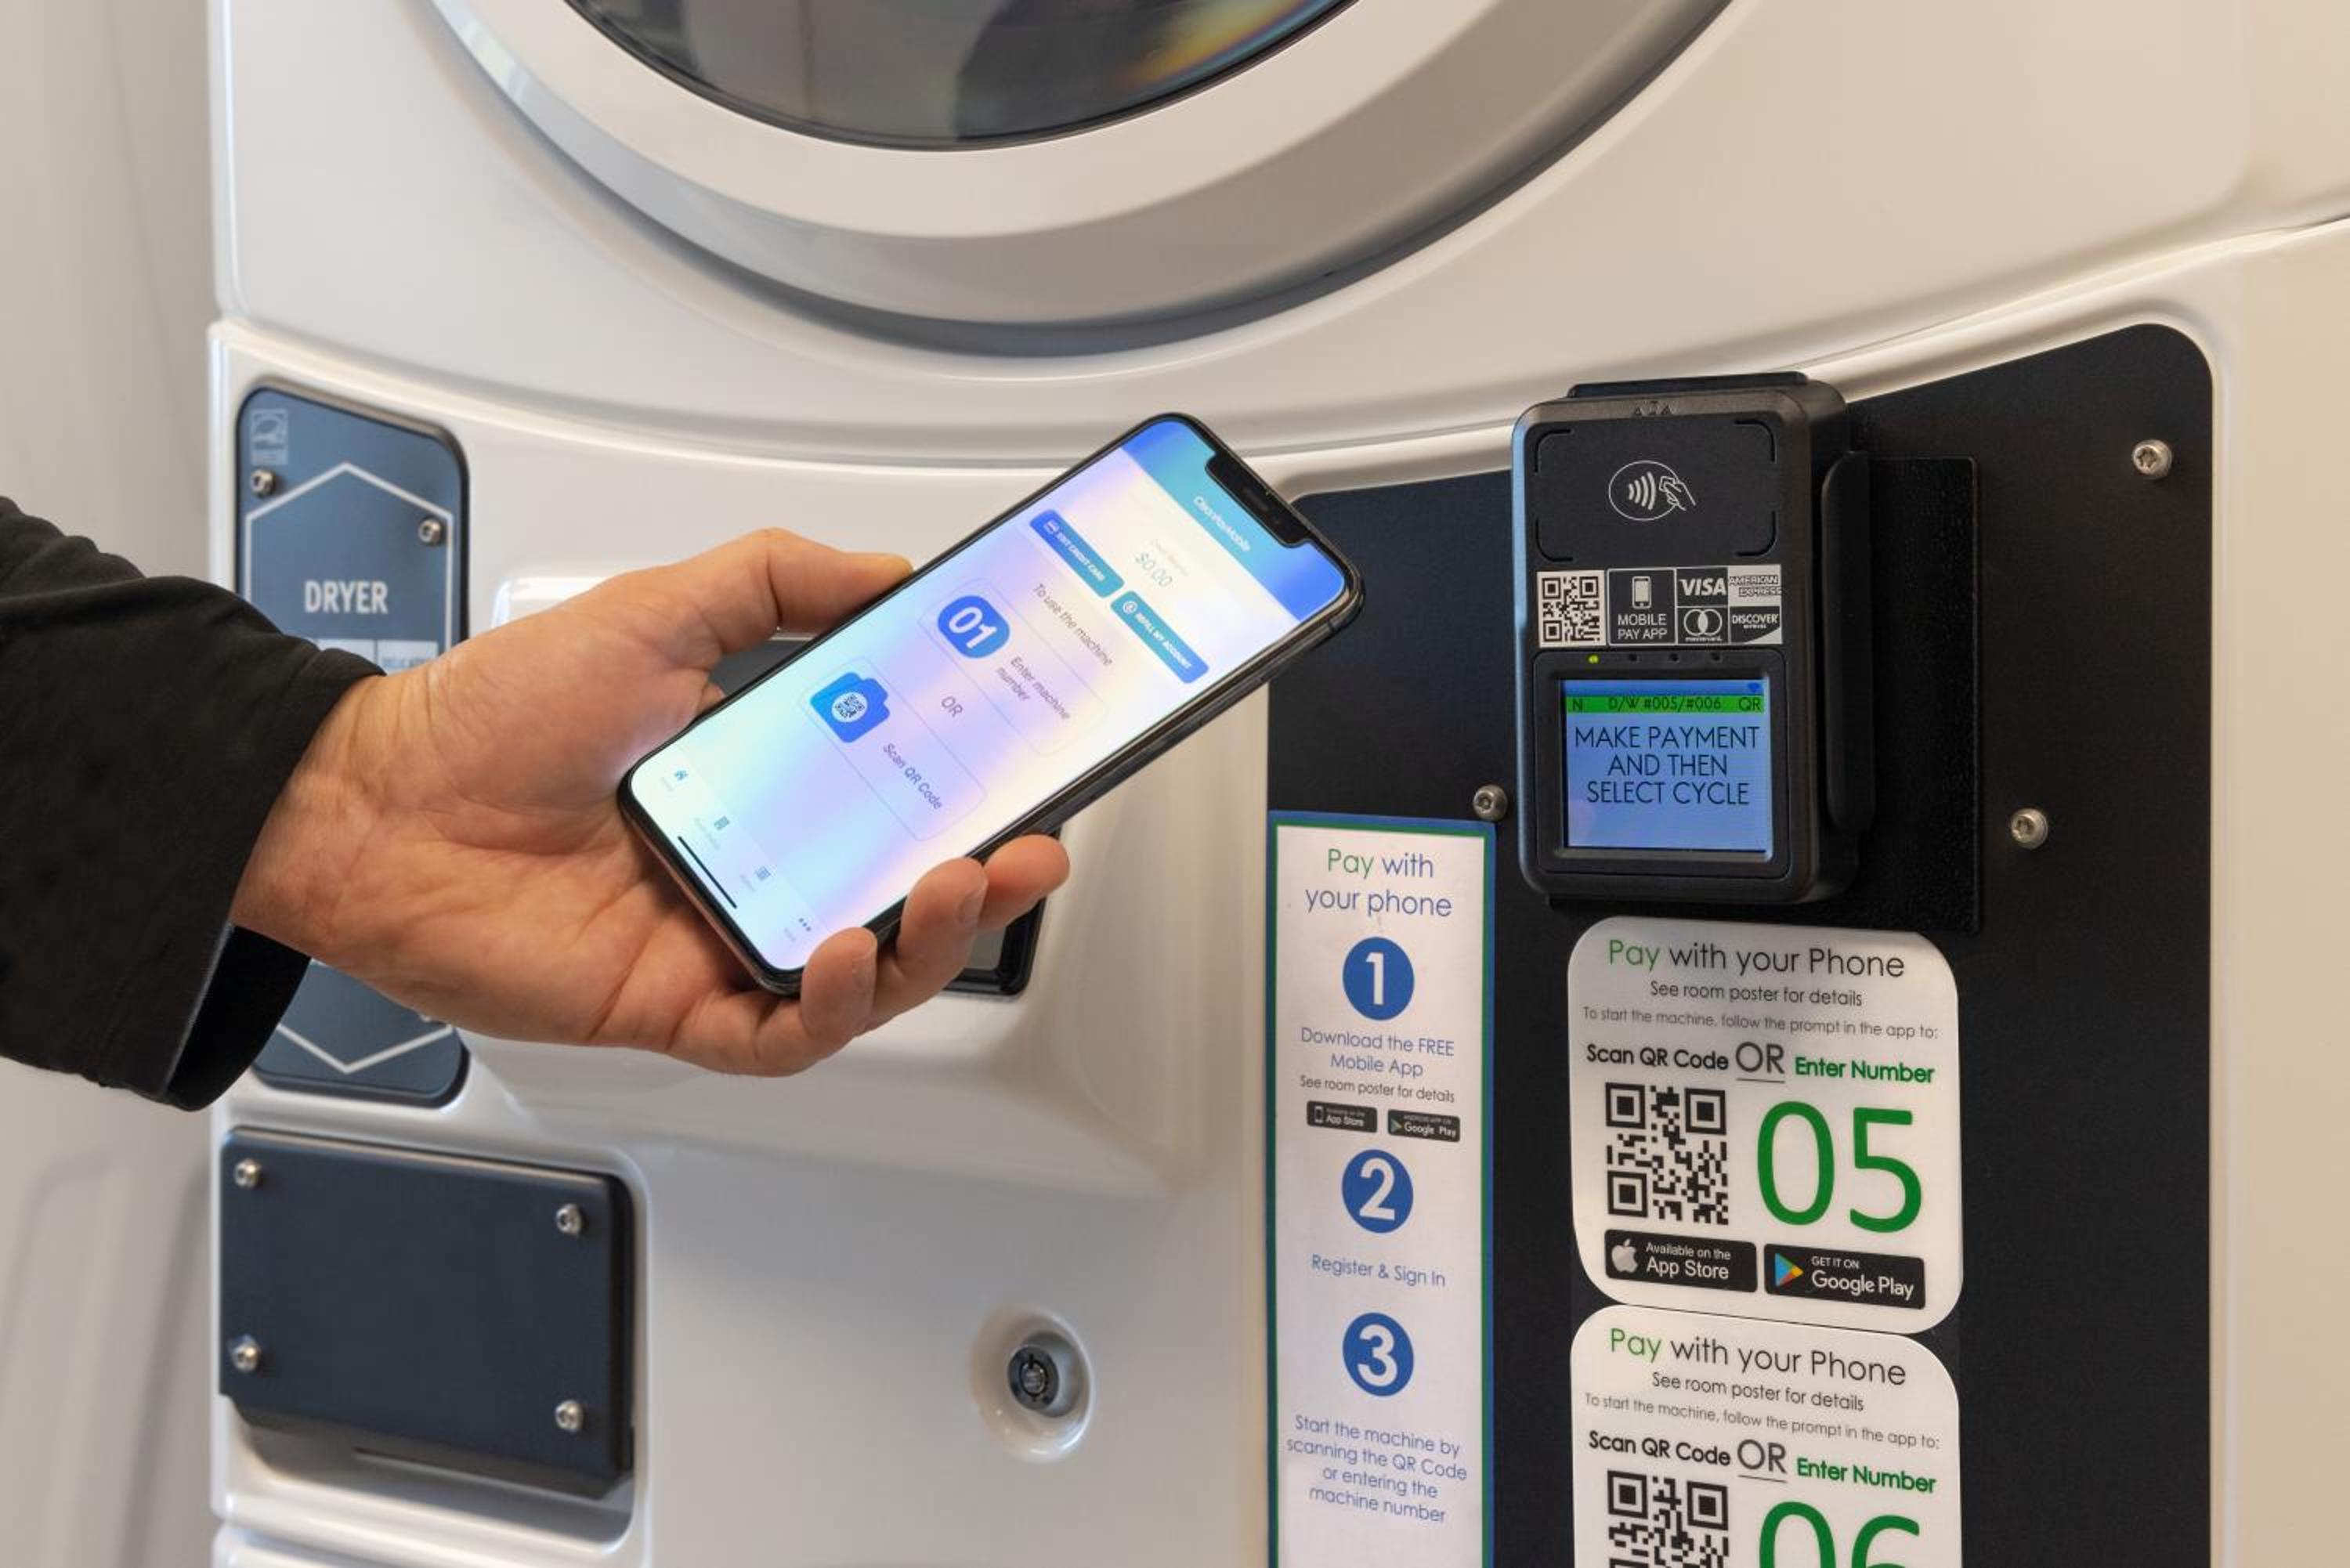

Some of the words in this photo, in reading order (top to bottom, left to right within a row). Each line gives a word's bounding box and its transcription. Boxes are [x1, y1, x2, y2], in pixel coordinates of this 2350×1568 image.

[1679, 578, 1727, 595] VISA
[1730, 575, 1779, 585] AMERICAN
[1740, 587, 1781, 597] EXPRESS
[304, 580, 388, 613] DRYER
[949, 607, 996, 649] 01
[1033, 585, 1049, 597] To
[1043, 596, 1062, 613] use
[1059, 612, 1079, 628] the
[1073, 627, 1115, 666] machine
[1618, 615, 1667, 626] MOBILE
[1732, 614, 1779, 623] DISCOVER
[1618, 629, 1641, 640] PAY
[1643, 629, 1668, 640] APP
[997, 670, 1030, 700] number
[1010, 657, 1036, 681] Enter
[1032, 681, 1072, 720] machine
[939, 695, 964, 716] OR
[1572, 698, 1583, 710] N
[1608, 696, 1640, 711] D/W
[1644, 696, 1721, 713] #005/#006
[1738, 697, 1761, 711] QR
[1575, 727, 1641, 748] MAKE
[1649, 728, 1759, 749] PAYMENT
[881, 742, 908, 767] Scan
[902, 767, 922, 783] QR
[916, 783, 945, 808] Code
[1607, 755, 1659, 776] AND
[1668, 755, 1727, 776] THEN
[1587, 782, 1668, 804] SELECT
[1673, 783, 1749, 804] CYCLE
[1328, 848, 1374, 879] Pay
[1383, 853, 1434, 877] with
[1306, 889, 1359, 912] your
[1368, 890, 1452, 917] phone
[1608, 939, 1660, 971] Pay
[1670, 943, 1725, 970] with
[1736, 951, 1799, 977] your
[1809, 948, 1904, 977] Phone
[1366, 952, 1384, 1005] 1
[1650, 981, 1678, 997] See
[1683, 985, 1724, 999] room
[1730, 986, 1778, 1004] poster
[1784, 988, 1805, 1003] for
[1809, 989, 1862, 1006] details
[1584, 1006, 1597, 1019] To
[1601, 1008, 1628, 1021] start
[1632, 1008, 1652, 1023] the
[1721, 1013, 1760, 1028] follow
[1764, 1017, 1785, 1030] the
[1790, 1019, 1840, 1035] prompt
[1843, 1021, 1856, 1034] in
[1859, 1023, 1881, 1035] the
[1886, 1025, 1915, 1040] app
[1919, 1025, 1939, 1039] to:
[1301, 1028, 1383, 1050] Download
[1387, 1037, 1412, 1053] the
[1419, 1039, 1454, 1057] FREE
[1330, 1054, 1383, 1072] Mobile
[1390, 1059, 1423, 1078] App
[1587, 1045, 1633, 1064] Scan
[1640, 1047, 1668, 1067] QR
[1674, 1049, 1729, 1071] Code
[1735, 1042, 1784, 1075] OR
[1795, 1057, 1846, 1078] Enter
[1852, 1060, 1934, 1083] Number
[1300, 1076, 1321, 1088] See
[1325, 1079, 1354, 1092] room
[1358, 1082, 1394, 1097] poster
[1397, 1085, 1412, 1097] for
[1417, 1088, 1455, 1103] details
[1326, 1115, 1342, 1125] App
[1343, 1117, 1365, 1126] Store
[1405, 1122, 1434, 1136] Google
[1758, 1100, 1922, 1234] 05
[1359, 1157, 1394, 1220] 2
[1647, 1242, 1693, 1256] Available
[1697, 1248, 1711, 1259] on
[1714, 1248, 1731, 1260] the
[1812, 1256, 1831, 1266] GET
[1832, 1258, 1842, 1267] IT
[1845, 1259, 1860, 1270] ON
[1311, 1254, 1373, 1276] Register
[1378, 1264, 1389, 1278] &
[1394, 1266, 1426, 1286] Sign
[1432, 1271, 1444, 1286] In
[1647, 1259, 1679, 1277] App
[1685, 1261, 1729, 1279] Store
[1812, 1270, 1875, 1295] Google
[1879, 1277, 1914, 1301] Play
[1358, 1323, 1397, 1386] 3
[1610, 1328, 1661, 1363] Pay
[1671, 1336, 1728, 1365] with
[1738, 1349, 1801, 1374] your
[1811, 1351, 1907, 1385] Phone
[1653, 1372, 1680, 1389] See
[1685, 1378, 1726, 1394] room
[1732, 1382, 1780, 1403] poster
[1786, 1389, 1806, 1404] for
[1811, 1392, 1864, 1411] details
[1295, 1414, 1329, 1435] Start
[1335, 1421, 1360, 1439] the
[1365, 1428, 1434, 1451] machine
[1441, 1439, 1460, 1458] by
[1585, 1393, 1599, 1406] To
[1603, 1396, 1629, 1411] start
[1633, 1397, 1654, 1412] the
[1723, 1409, 1762, 1425] follow
[1766, 1415, 1788, 1429] the
[1791, 1419, 1842, 1438] prompt
[1846, 1425, 1856, 1437] in
[1862, 1426, 1883, 1442] the
[1888, 1433, 1918, 1448] app
[1921, 1433, 1940, 1450] to:
[1287, 1437, 1358, 1465] scanning
[1363, 1450, 1387, 1467] the
[1393, 1454, 1415, 1472] QR
[1421, 1458, 1467, 1480] Code
[1589, 1431, 1636, 1454] Scan
[1642, 1438, 1669, 1458] QR
[1676, 1442, 1730, 1466] Code
[1737, 1439, 1787, 1474] OR
[1797, 1458, 1847, 1481] Enter
[1853, 1465, 1936, 1493] Number
[1322, 1467, 1337, 1479] or
[1343, 1469, 1407, 1496] entering
[1412, 1482, 1438, 1498] the
[1309, 1485, 1378, 1511] machine
[1383, 1499, 1444, 1523] number
